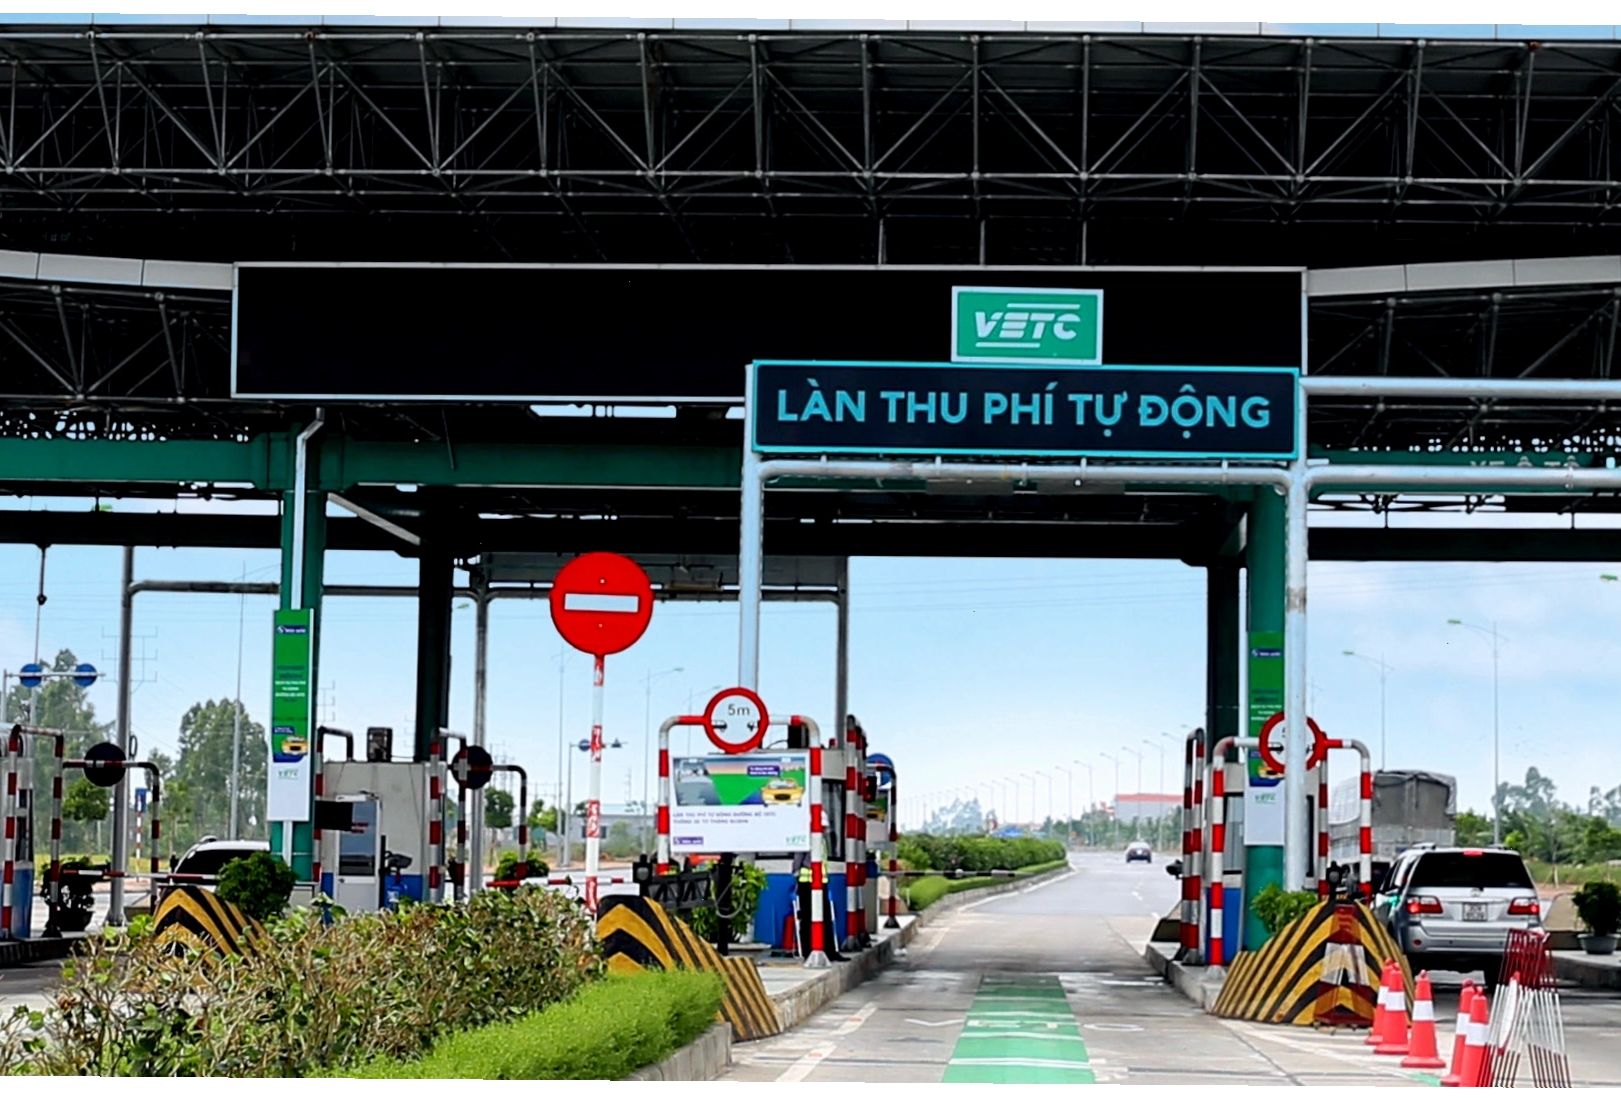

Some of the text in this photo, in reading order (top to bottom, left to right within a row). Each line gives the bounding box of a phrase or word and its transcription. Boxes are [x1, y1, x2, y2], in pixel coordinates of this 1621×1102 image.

[974, 310, 1082, 341] VETC
[777, 378, 1271, 439] LÀN THU PHÍ TỰ ĐỘNG
[728, 703, 750, 716] 5m
